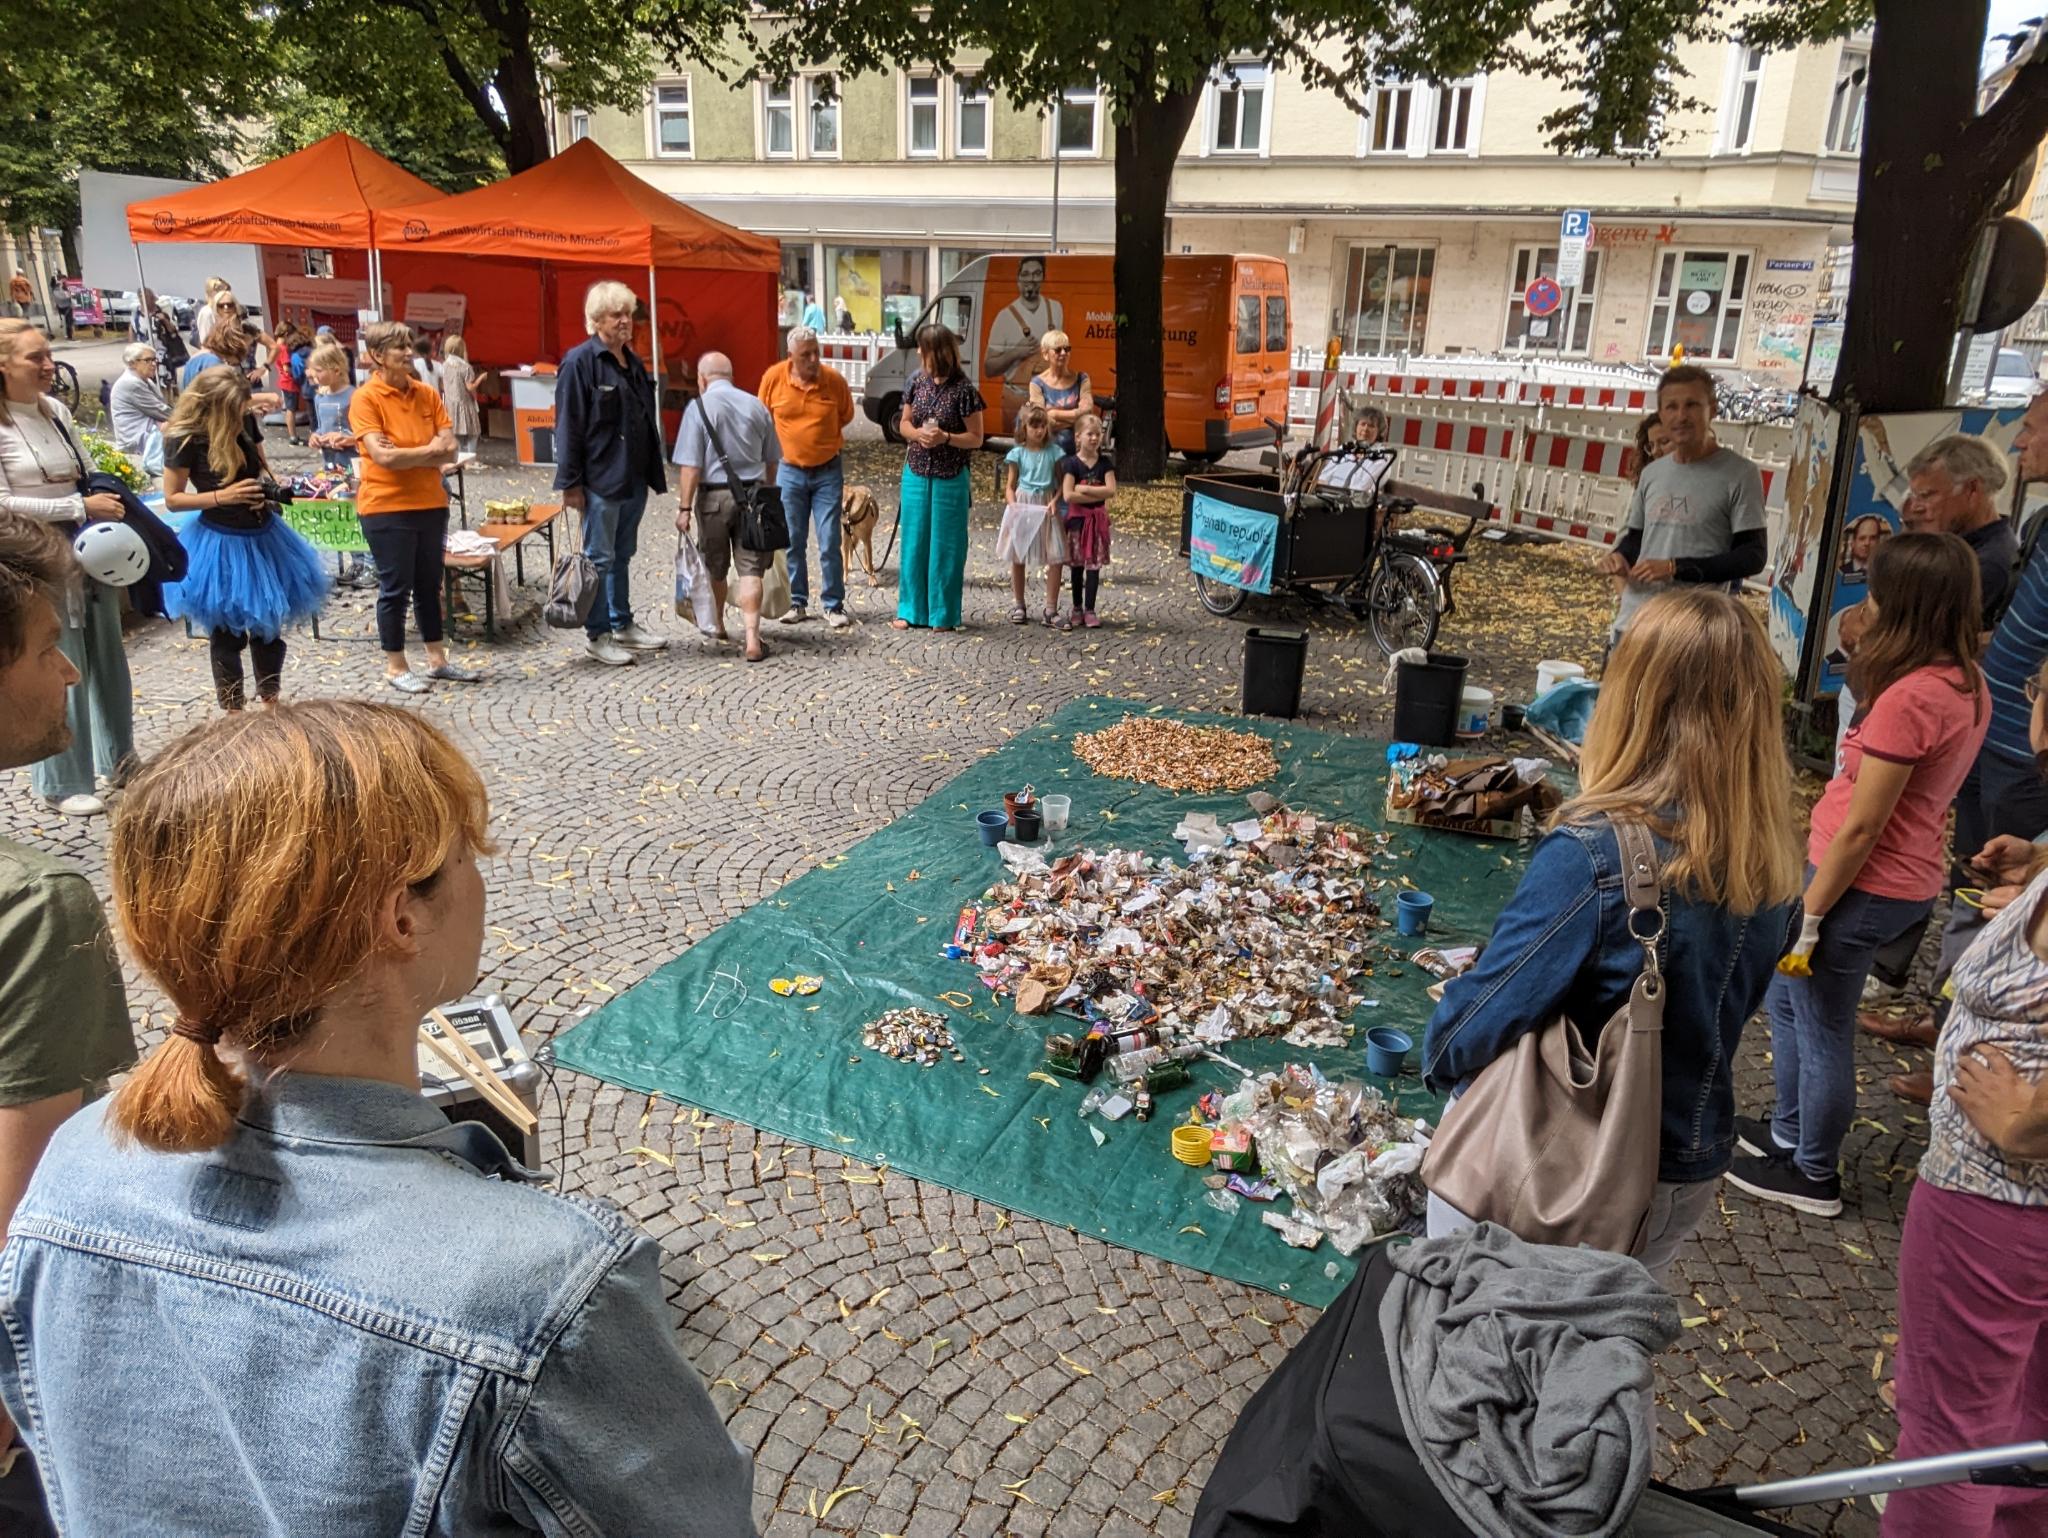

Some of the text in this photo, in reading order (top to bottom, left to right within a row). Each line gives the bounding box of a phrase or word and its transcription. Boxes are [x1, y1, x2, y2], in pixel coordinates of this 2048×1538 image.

[1566, 214, 1582, 234] P
[569, 234, 621, 247] München
[1202, 512, 1227, 534] rehab
[299, 523, 368, 545] Statio
